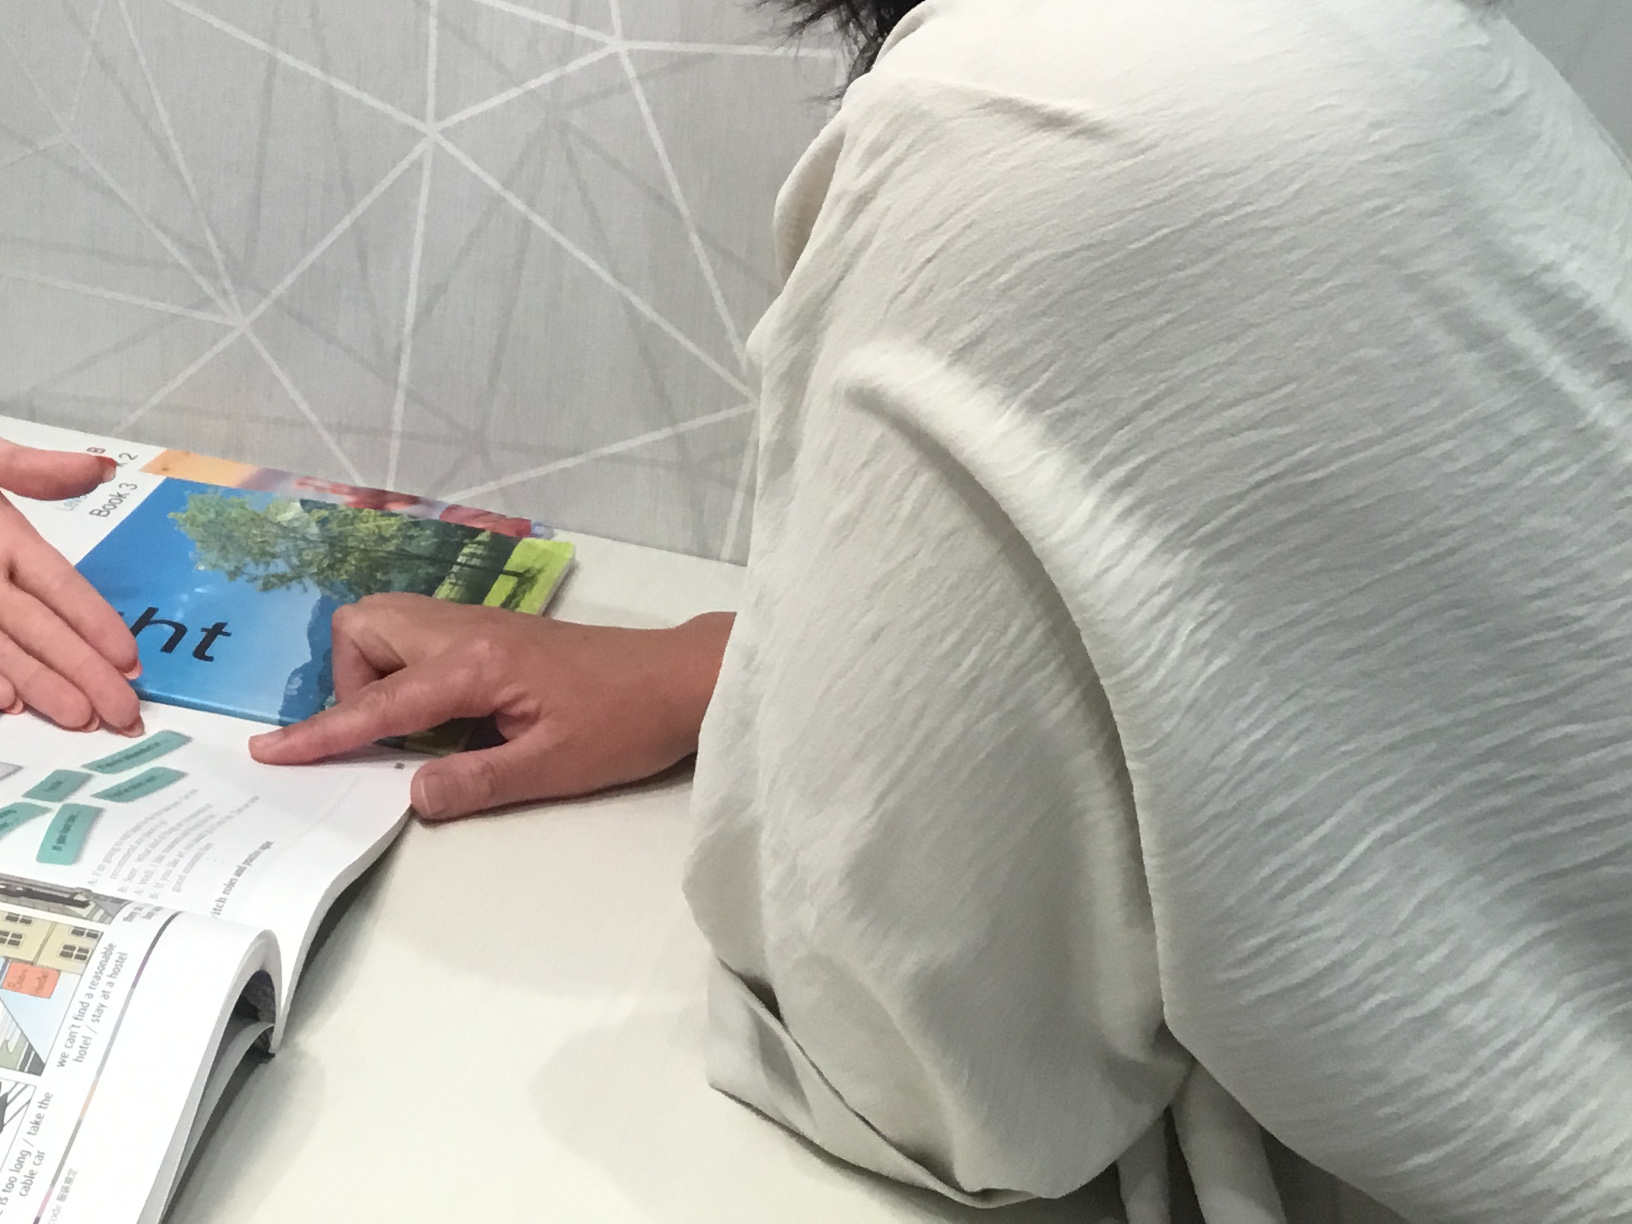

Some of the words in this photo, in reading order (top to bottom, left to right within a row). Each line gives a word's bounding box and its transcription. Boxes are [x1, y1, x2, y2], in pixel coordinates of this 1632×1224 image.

[89, 491, 130, 518] Book
[118, 482, 138, 491] 3
[118, 606, 232, 662] ht
[210, 897, 227, 917] itch
[88, 942, 117, 991] reasonable
[106, 951, 128, 979] hostel
[101, 989, 112, 1001] at
[72, 1000, 90, 1022] find
[91, 1002, 109, 1024] stay
[65, 1024, 81, 1049] can't
[56, 1052, 70, 1068] we
[72, 1035, 93, 1063] hotel
[37, 1092, 54, 1110] the
[26, 1113, 45, 1136] take
[9, 1149, 32, 1173] long
[1, 1176, 18, 1194] too
[19, 1169, 38, 1197] cable
[32, 1150, 46, 1166] car
